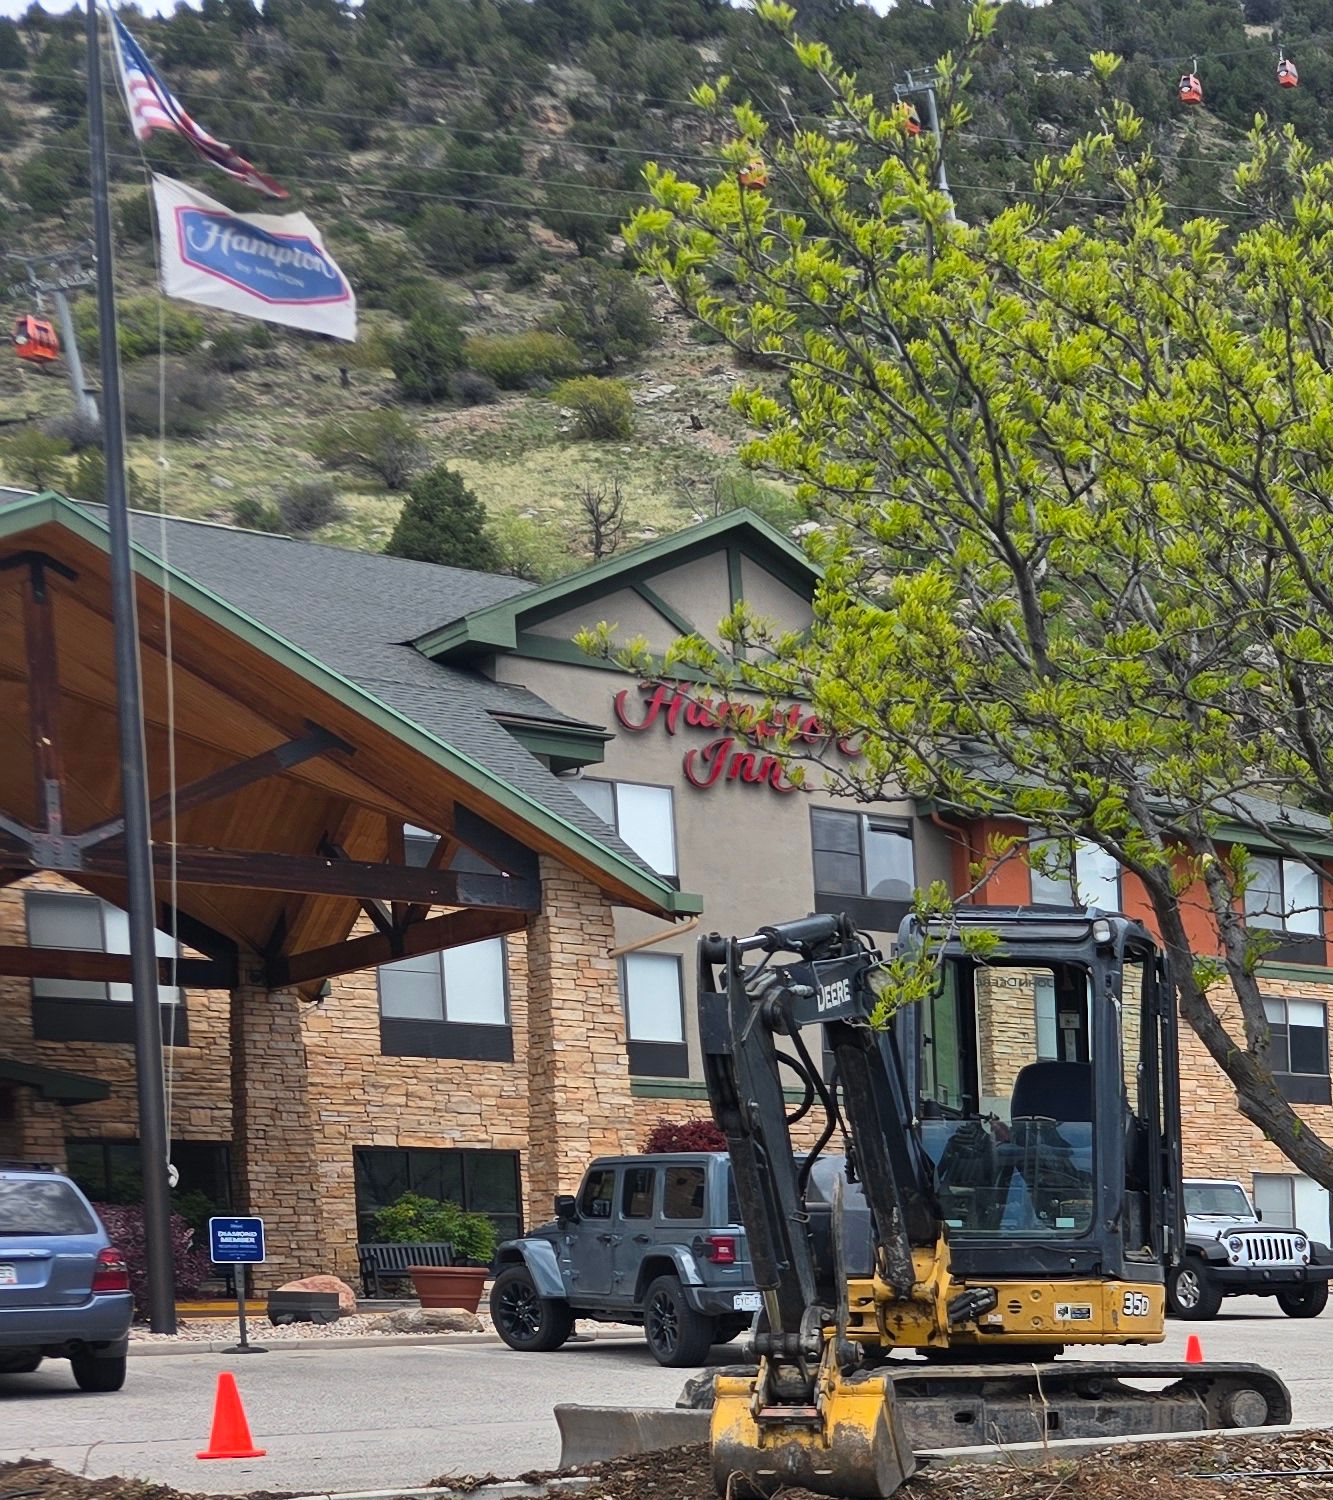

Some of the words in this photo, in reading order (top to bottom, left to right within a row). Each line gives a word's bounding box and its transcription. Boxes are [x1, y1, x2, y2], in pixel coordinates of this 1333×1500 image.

[186, 220, 336, 279] Hampton
[614, 680, 869, 756] Hamto
[683, 737, 797, 793] Inn
[817, 978, 851, 1012] DEERE
[1122, 1291, 1149, 1316] 35D
